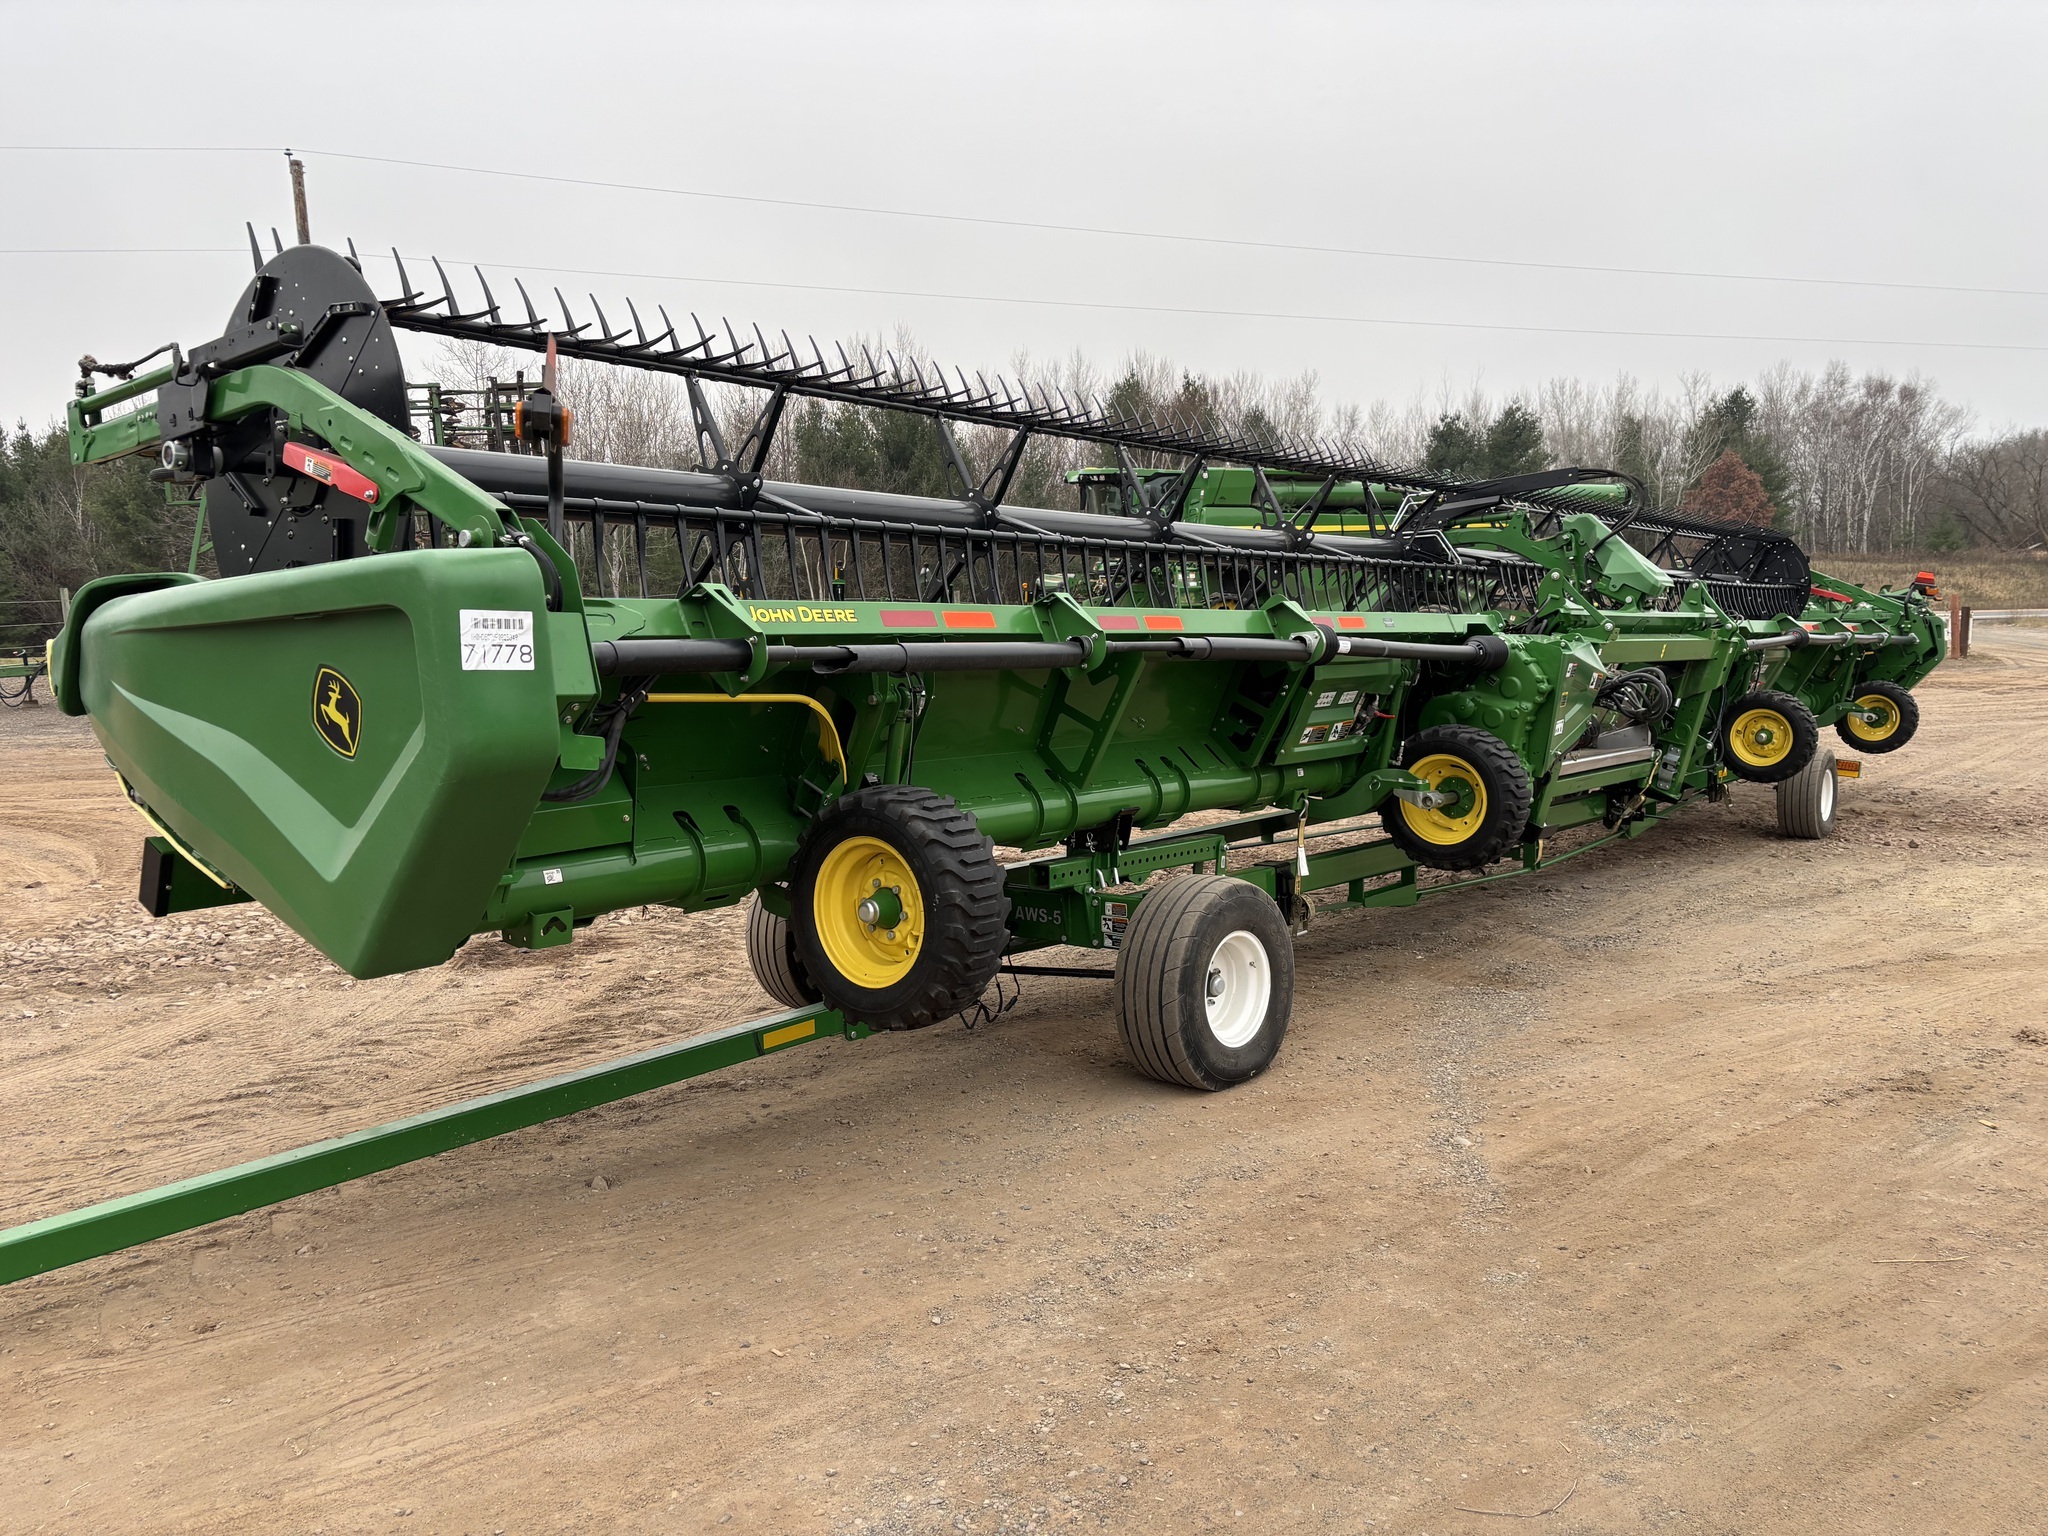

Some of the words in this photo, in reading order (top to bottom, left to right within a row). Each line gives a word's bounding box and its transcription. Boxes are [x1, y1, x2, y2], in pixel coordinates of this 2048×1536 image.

[749, 605, 797, 623] JOHN
[796, 605, 859, 623] DEERE
[463, 643, 533, 664] 71778
[1015, 905, 1062, 925] AWS-5
